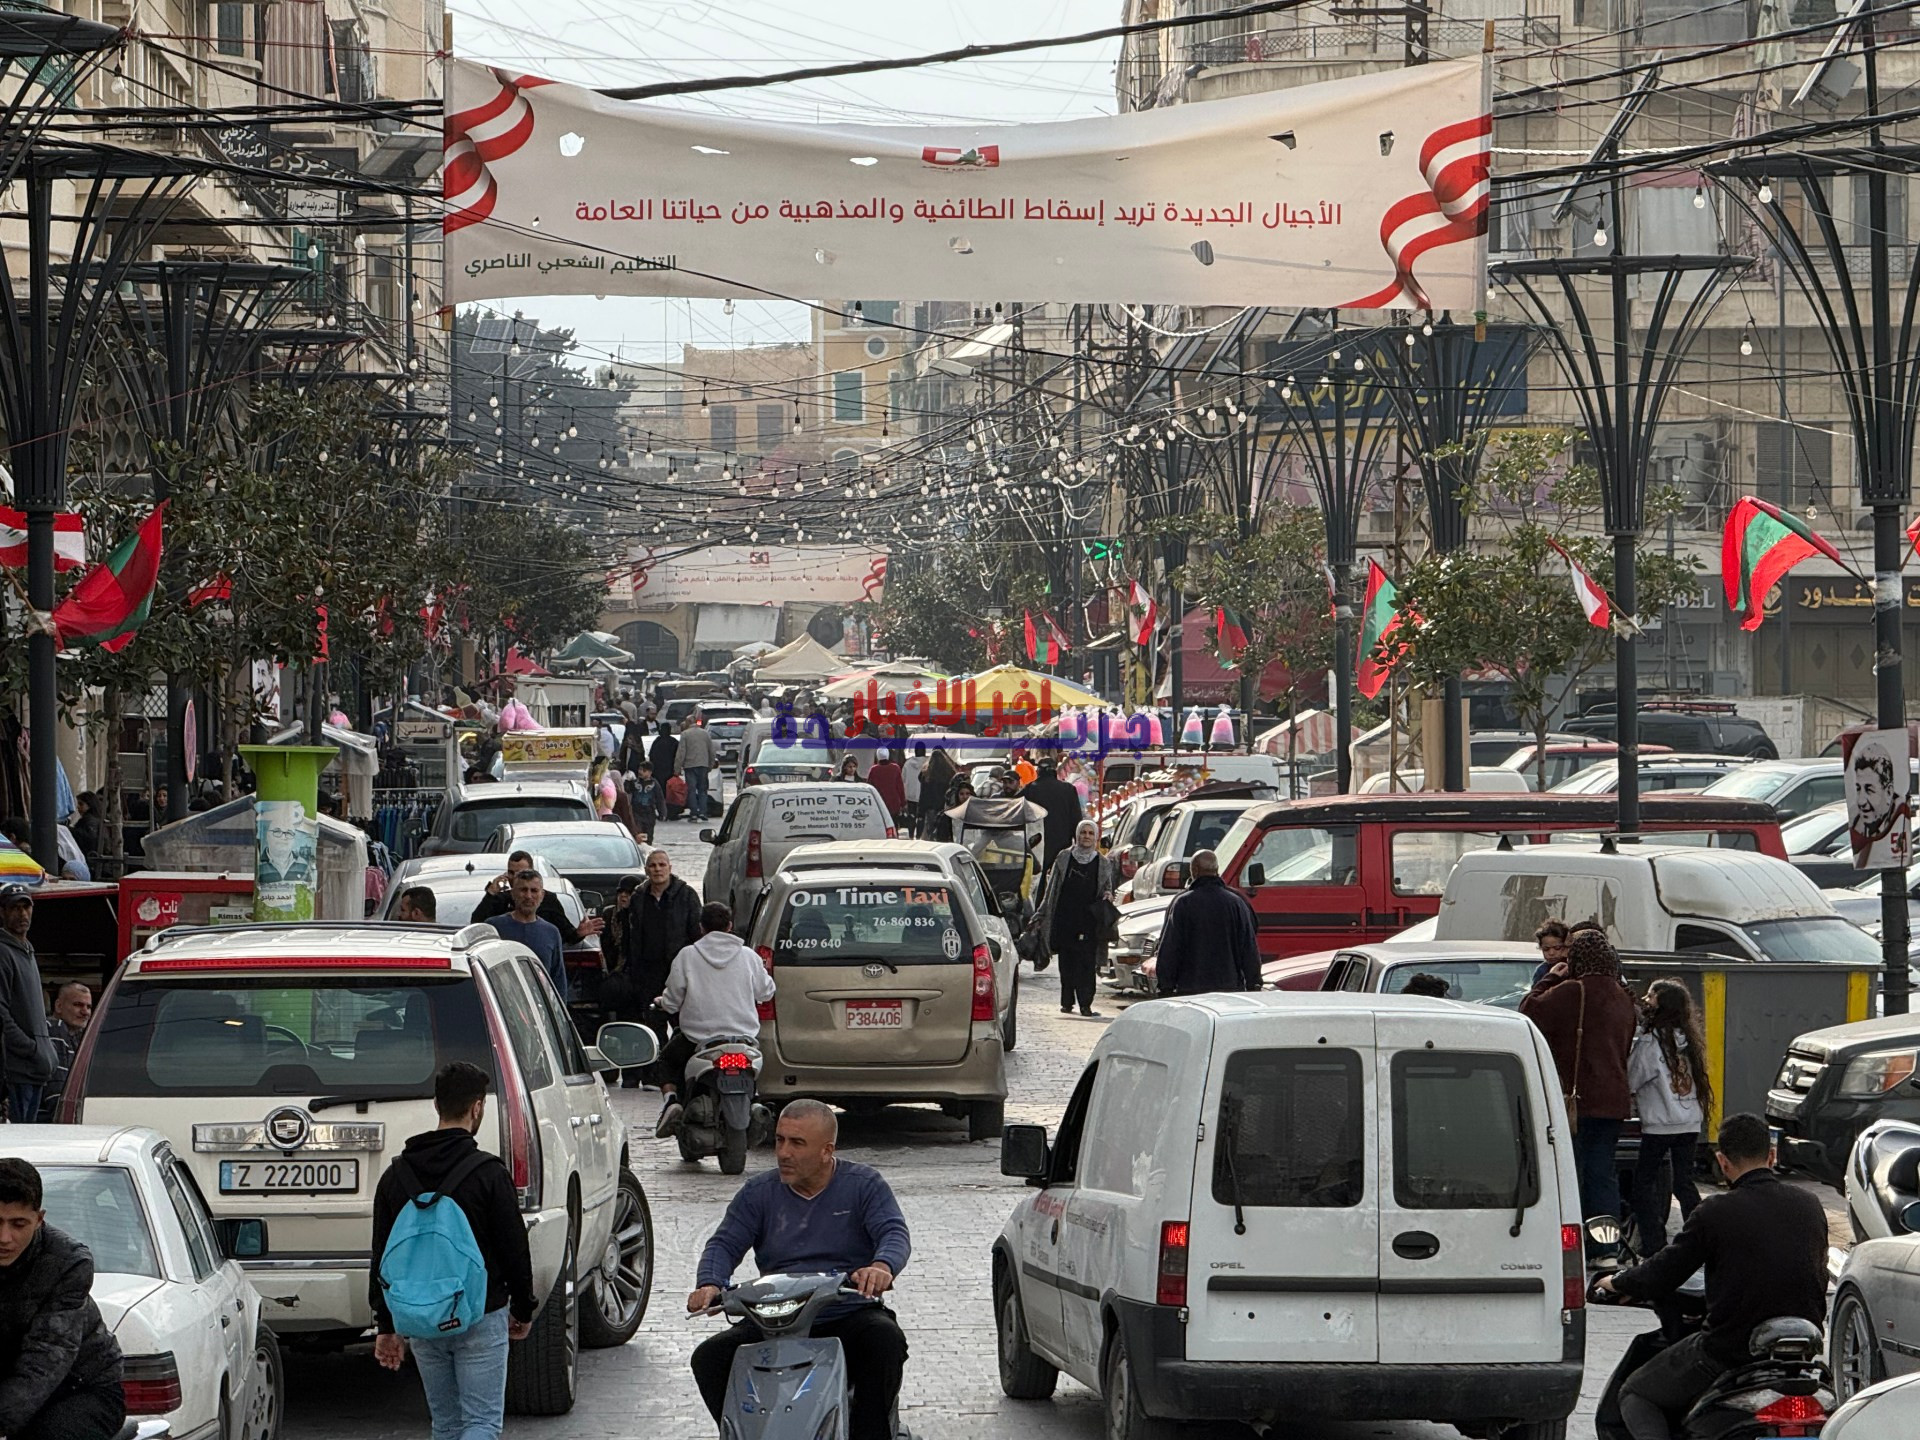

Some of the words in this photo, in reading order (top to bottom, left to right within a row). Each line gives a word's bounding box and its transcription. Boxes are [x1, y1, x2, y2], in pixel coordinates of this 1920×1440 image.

[244, 143, 267, 158] الدكتور
[575, 200, 652, 222] العامة
[663, 199, 721, 223] حياتنا
[732, 204, 769, 225] من
[780, 198, 904, 224] والمذهبية
[914, 198, 1014, 223] الطائفية
[1025, 199, 1104, 227] إسقاط
[1115, 203, 1156, 227] تريد
[1163, 201, 1253, 228] الجديدة
[1262, 200, 1341, 229] الأجيال
[464, 253, 531, 278] الناصري
[537, 255, 605, 275] الشعبي
[610, 255, 677, 275] التنظيم
[772, 795, 828, 809] Prime
[832, 794, 872, 806] Taxi
[789, 890, 827, 907] On
[835, 886, 898, 905] Time
[901, 888, 949, 904] Taxi
[872, 917, 912, 927] 76-860
[914, 917, 936, 927] 836
[778, 939, 818, 949] 70-629
[820, 938, 842, 949] 640
[847, 1011, 901, 1027] P384406
[238, 1164, 251, 1187] Z
[264, 1164, 342, 1187] 222000
[1209, 1261, 1246, 1270] OPEL
